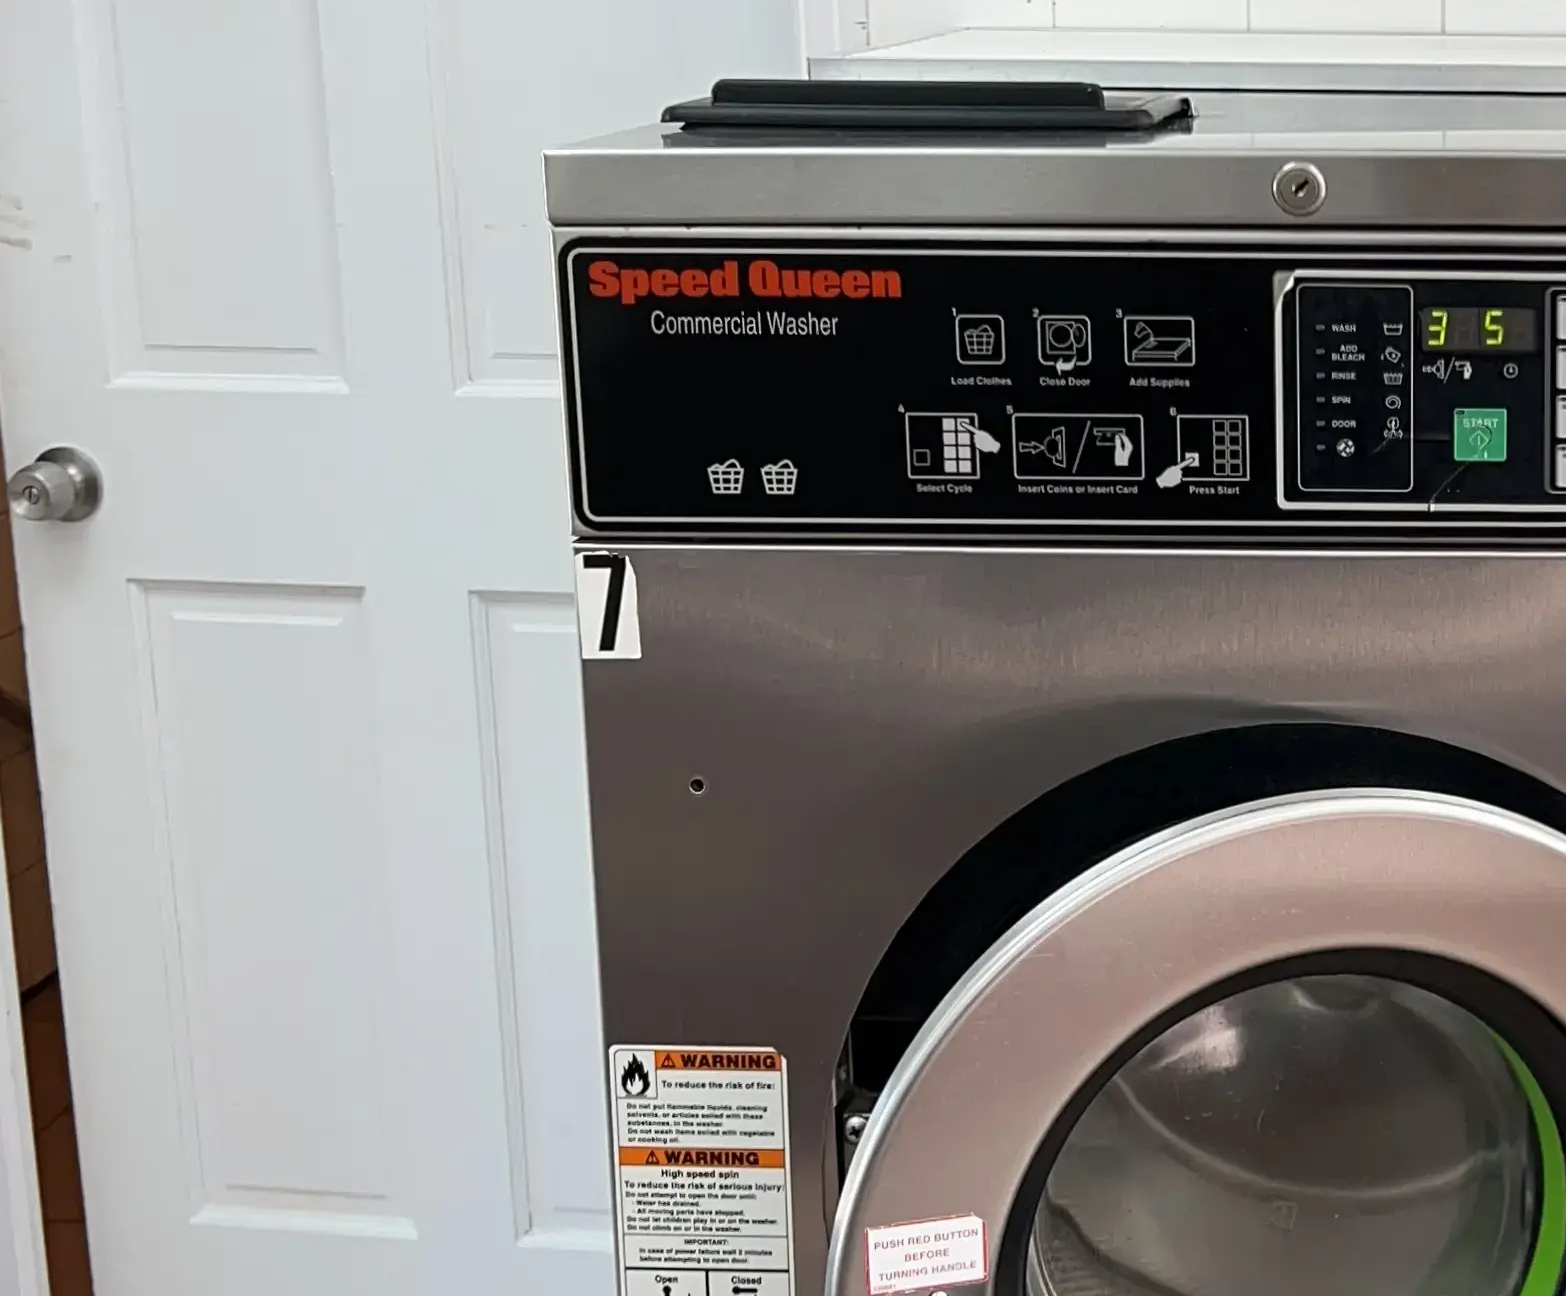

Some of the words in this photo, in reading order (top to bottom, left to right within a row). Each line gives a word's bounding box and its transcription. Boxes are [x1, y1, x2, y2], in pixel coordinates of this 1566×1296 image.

[588, 261, 739, 304] Speed
[749, 261, 901, 297] Queen
[651, 310, 762, 336] Commercial
[768, 311, 838, 336] Washer
[1428, 310, 1448, 346] 3
[1484, 309, 1503, 345] 5
[1331, 324, 1356, 334] WASH
[1340, 345, 1358, 353] ADD
[1331, 353, 1365, 362] BLEACH
[1331, 372, 1357, 380] RINSE
[951, 377, 974, 386] Load
[976, 377, 1012, 387] Clothes
[1040, 377, 1066, 387] Close
[1069, 377, 1090, 387] Door
[1129, 377, 1148, 387] Add
[1150, 377, 1190, 388] Supplies
[1331, 396, 1351, 404] SPIN
[1331, 420, 1356, 428] DOOR
[1462, 418, 1498, 428] START
[917, 484, 944, 493] Select
[947, 484, 972, 494] Cycle
[1018, 485, 1045, 494] Insert
[1047, 485, 1073, 494] Coins
[1076, 486, 1085, 494] or
[1087, 485, 1114, 494] Insert
[1116, 485, 1138, 494] Card
[1189, 486, 1214, 495] Press
[1217, 486, 1239, 495] Start
[583, 555, 626, 651] 7
[681, 1055, 776, 1069] WARNING
[662, 1080, 672, 1088] To
[675, 1081, 706, 1089] reduce
[709, 1081, 723, 1089] the
[725, 1081, 742, 1089] risk
[664, 1150, 759, 1165] WARNING
[661, 1169, 683, 1179] High
[686, 1171, 716, 1179] speed
[719, 1171, 739, 1179] spin
[755, 1184, 784, 1192] injury:
[874, 1238, 904, 1250] PUSH
[908, 1235, 930, 1245] RED
[934, 1228, 978, 1242] BUTTON
[904, 1248, 950, 1262] BEFORE
[878, 1268, 928, 1281] TURNING
[932, 1261, 976, 1274] HANDLE
[655, 1275, 678, 1284] Open
[731, 1276, 762, 1284] Closed
